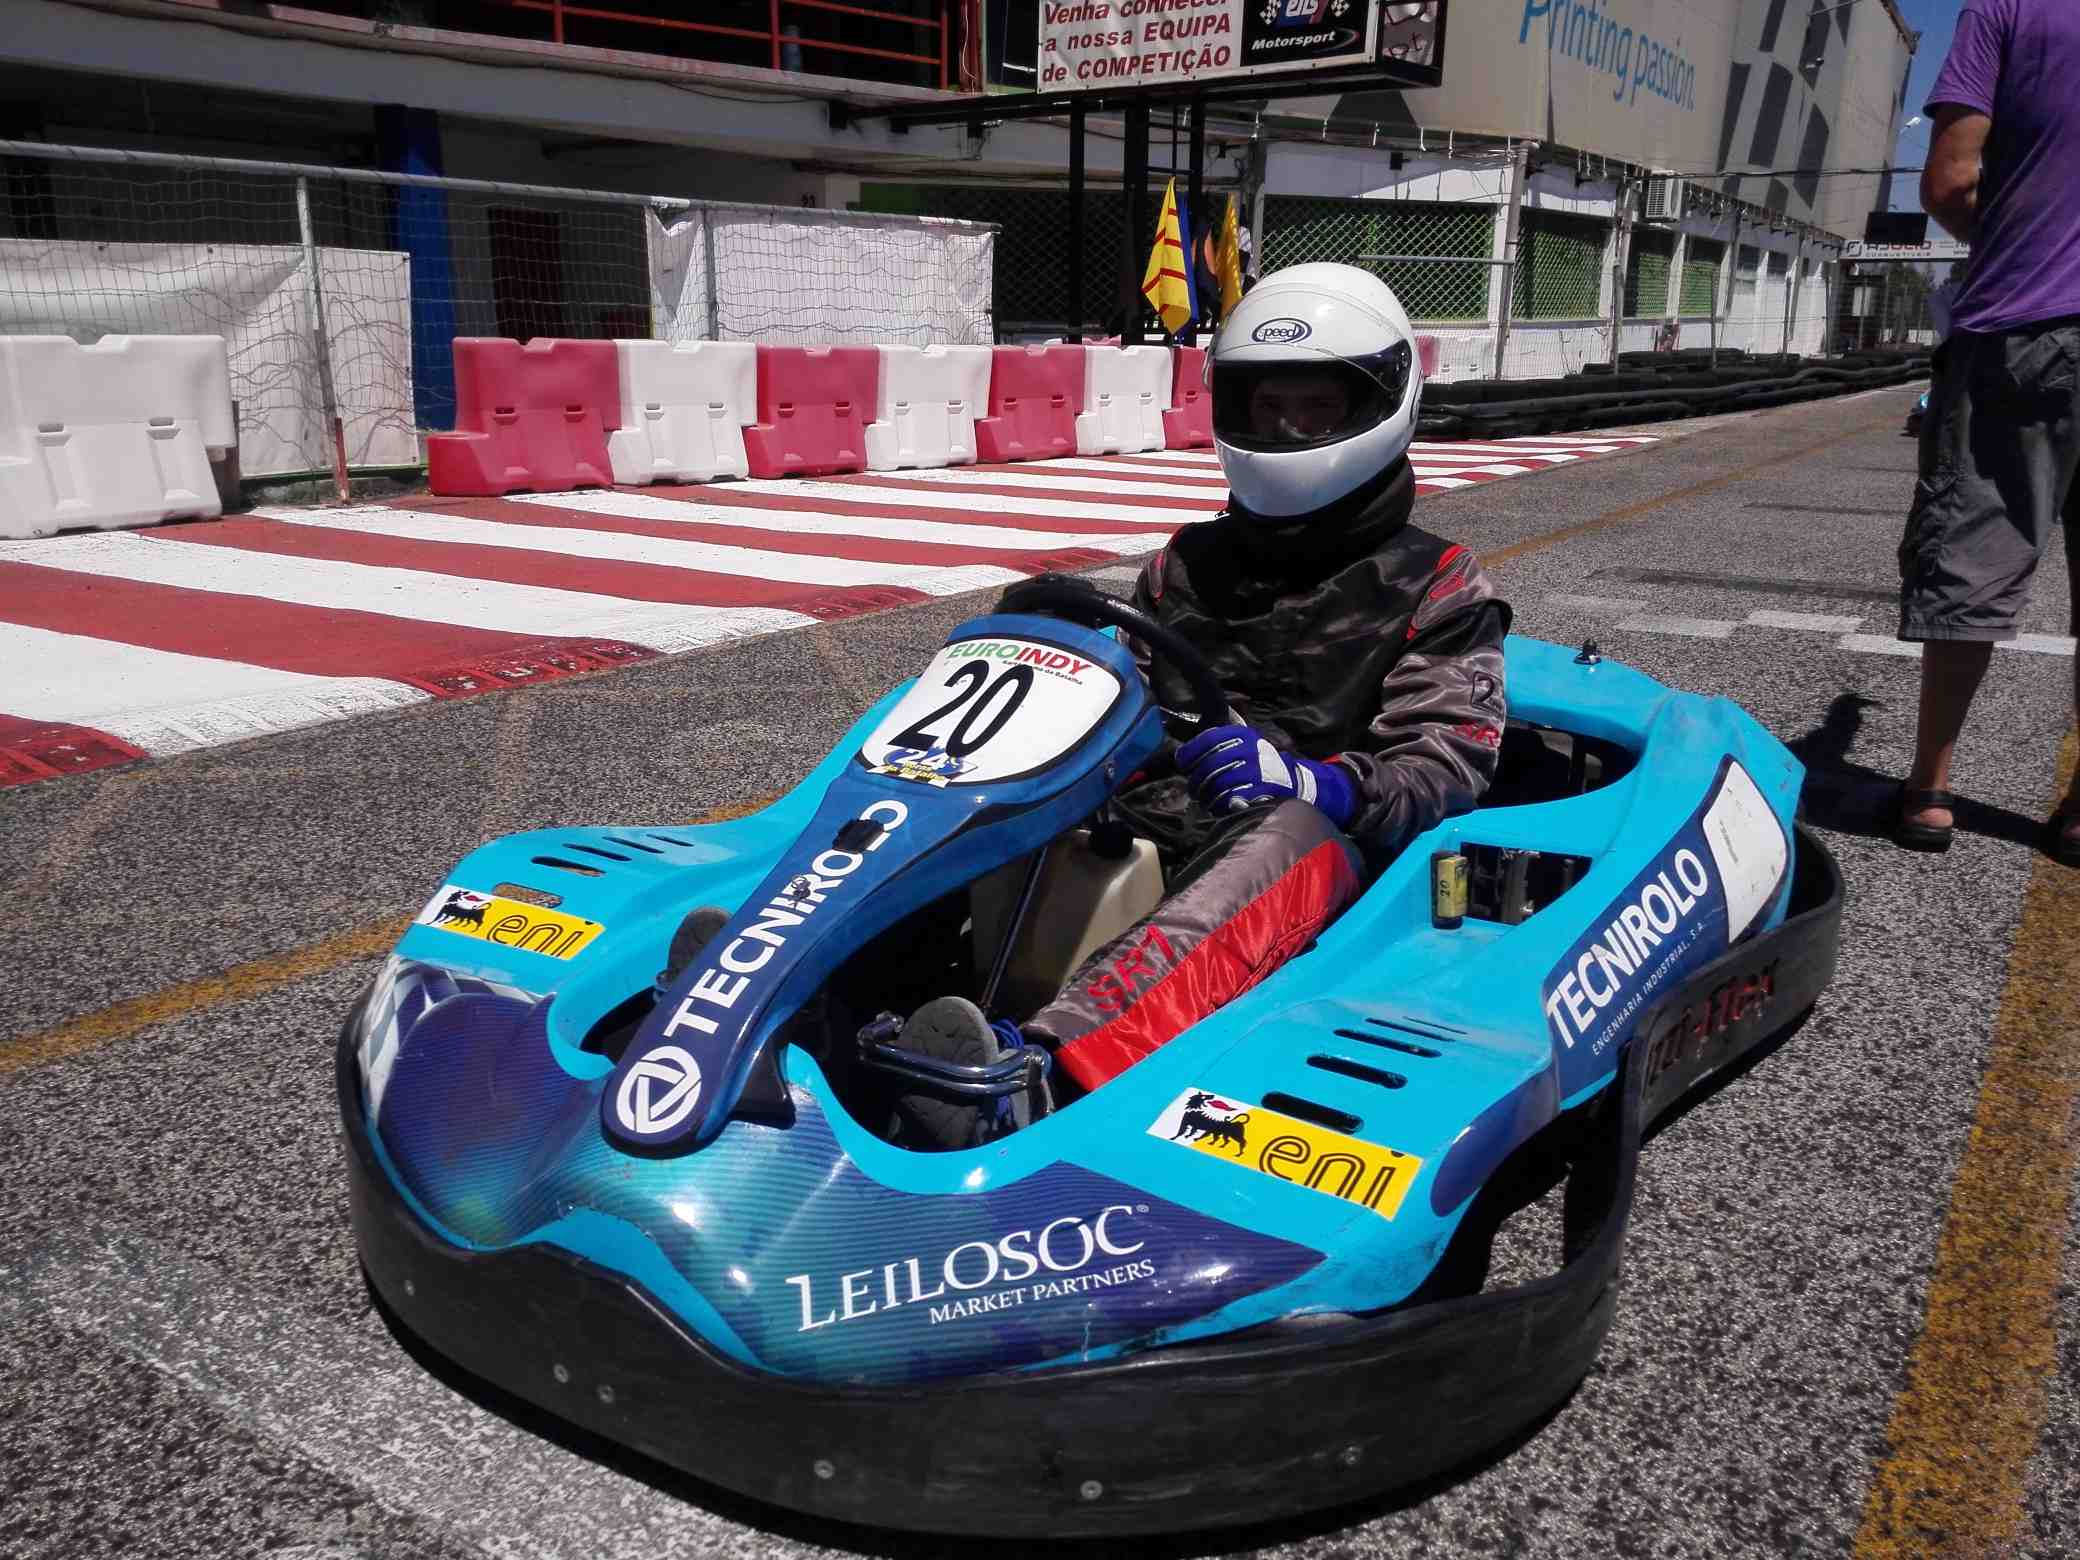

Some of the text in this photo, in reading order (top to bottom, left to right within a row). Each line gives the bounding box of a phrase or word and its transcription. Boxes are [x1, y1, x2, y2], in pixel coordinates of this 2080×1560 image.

[1044, 2, 1110, 25] Venha
[1044, 12, 1231, 53] a nossa EQUIPA
[1251, 30, 1336, 51] Motorsport
[1042, 42, 1231, 83] de COMPETIÇÃO
[1518, 0, 1634, 102] Printing
[948, 642, 1093, 675] EUROINDY
[887, 659, 1034, 757] 20
[486, 914, 594, 958] eni
[1546, 848, 1709, 1049] TECNIROLO
[1591, 992, 1643, 1056] ENGENHARIA
[1259, 1135, 1405, 1210] eni
[929, 1258, 1156, 1324] MARKET PARTNERS
